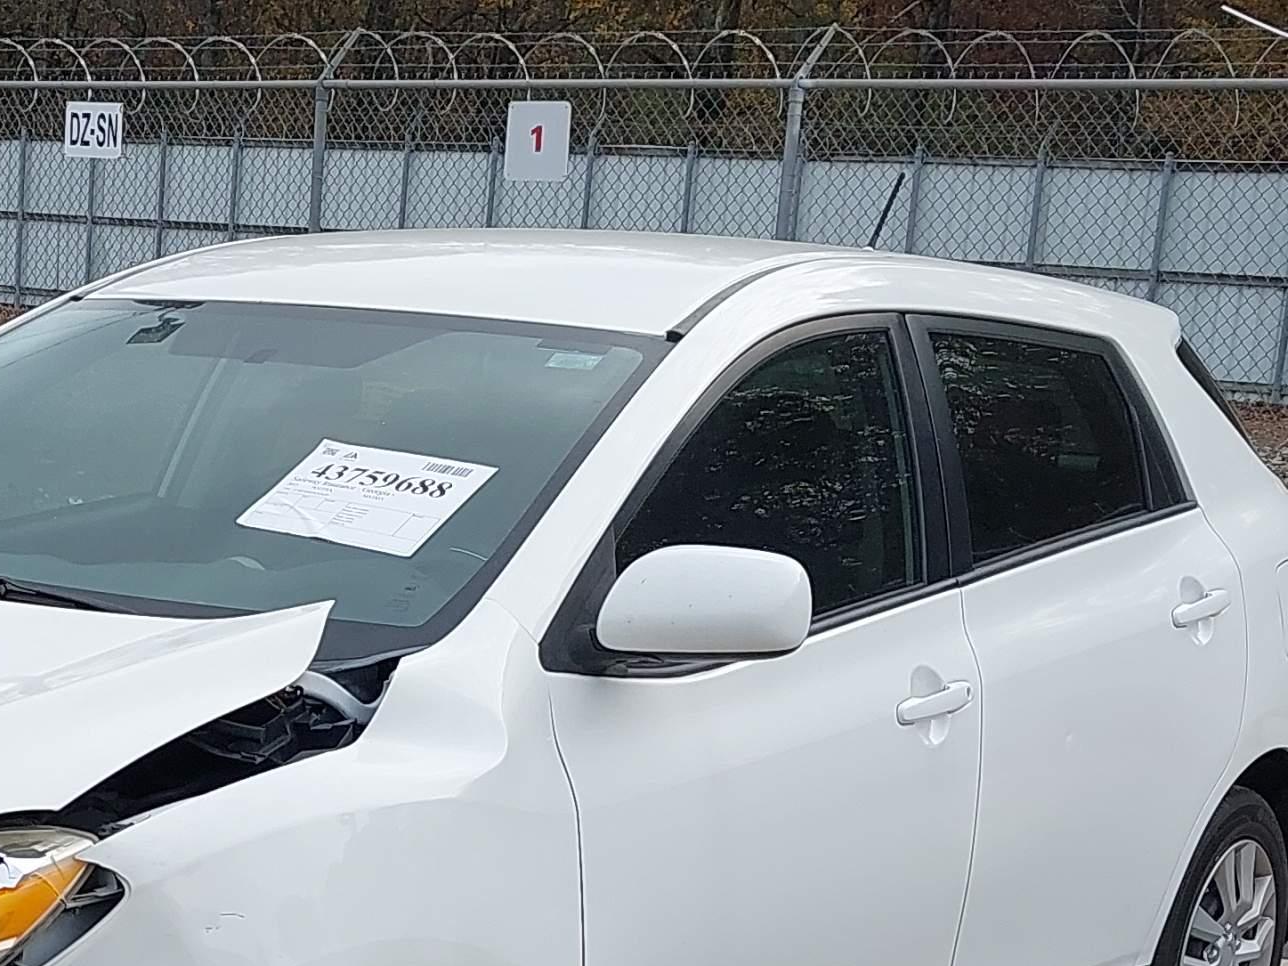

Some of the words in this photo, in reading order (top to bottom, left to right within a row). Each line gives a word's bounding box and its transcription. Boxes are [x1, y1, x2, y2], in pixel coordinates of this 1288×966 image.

[70, 112, 118, 148] DZ-SN
[531, 125, 543, 153] 1
[311, 463, 453, 499] 43759688
